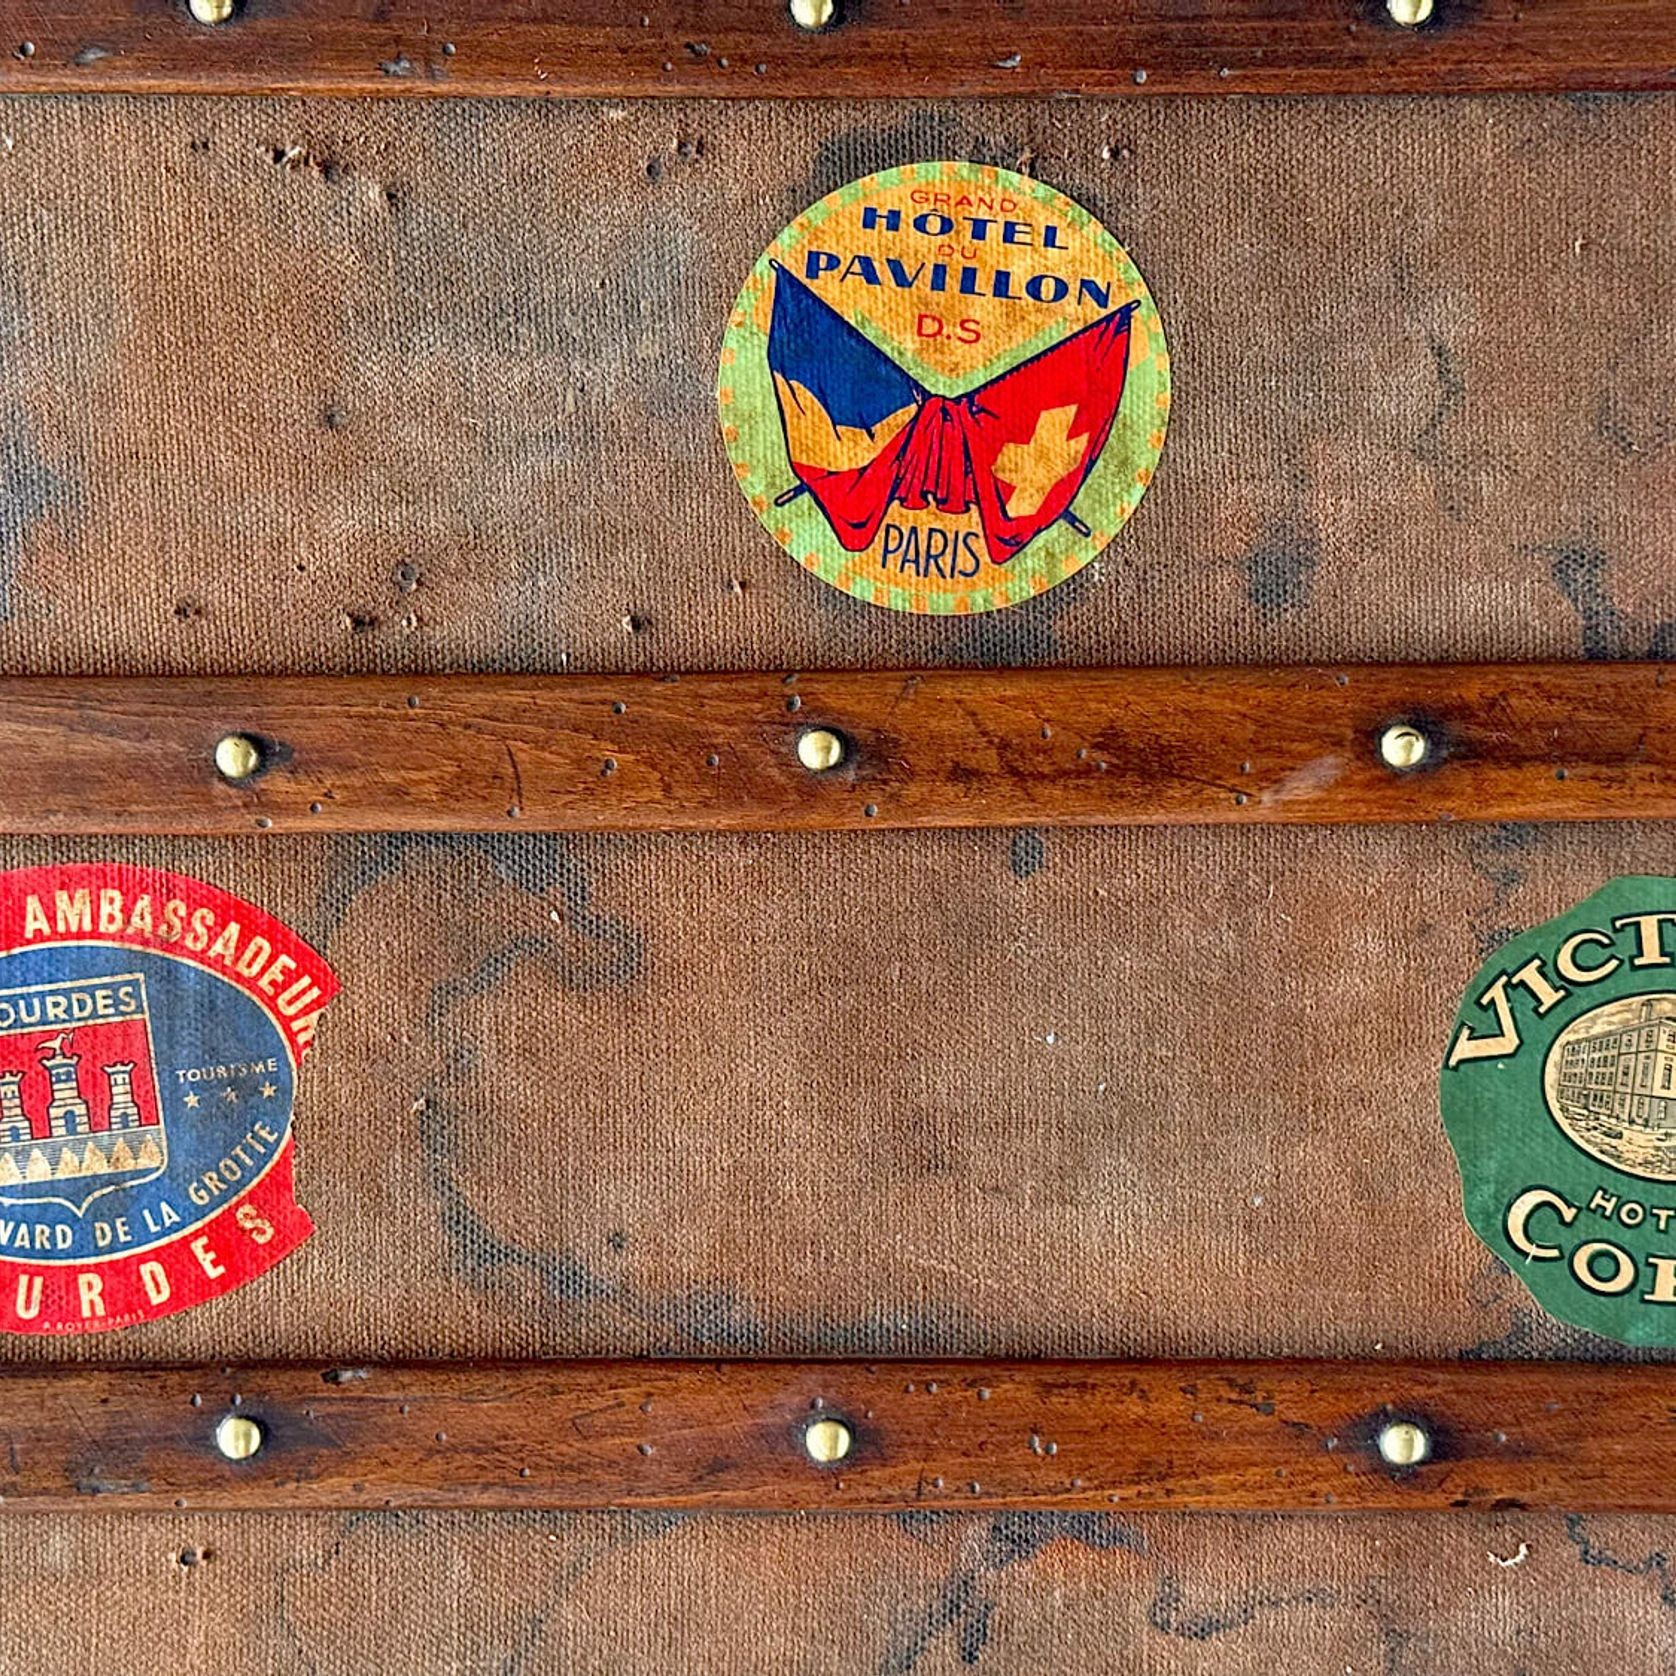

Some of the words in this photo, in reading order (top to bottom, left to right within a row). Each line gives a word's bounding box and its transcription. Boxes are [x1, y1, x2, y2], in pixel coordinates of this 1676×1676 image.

[910, 189, 1017, 213] GRAND
[861, 206, 1069, 250] HÔTEL
[937, 244, 977, 260] DU
[805, 250, 1111, 309] PAVILLON
[916, 313, 982, 344] D.S
[881, 523, 981, 579] PARIS
[24, 888, 327, 1060] AMBASSADEUR
[1447, 911, 1676, 1069] VICT
[175, 1058, 278, 1084] TOURISME
[94, 1217, 132, 1248] DE
[142, 1201, 181, 1233] LA
[188, 1121, 279, 1206] GROTTE
[1588, 1189, 1676, 1231] HOT
